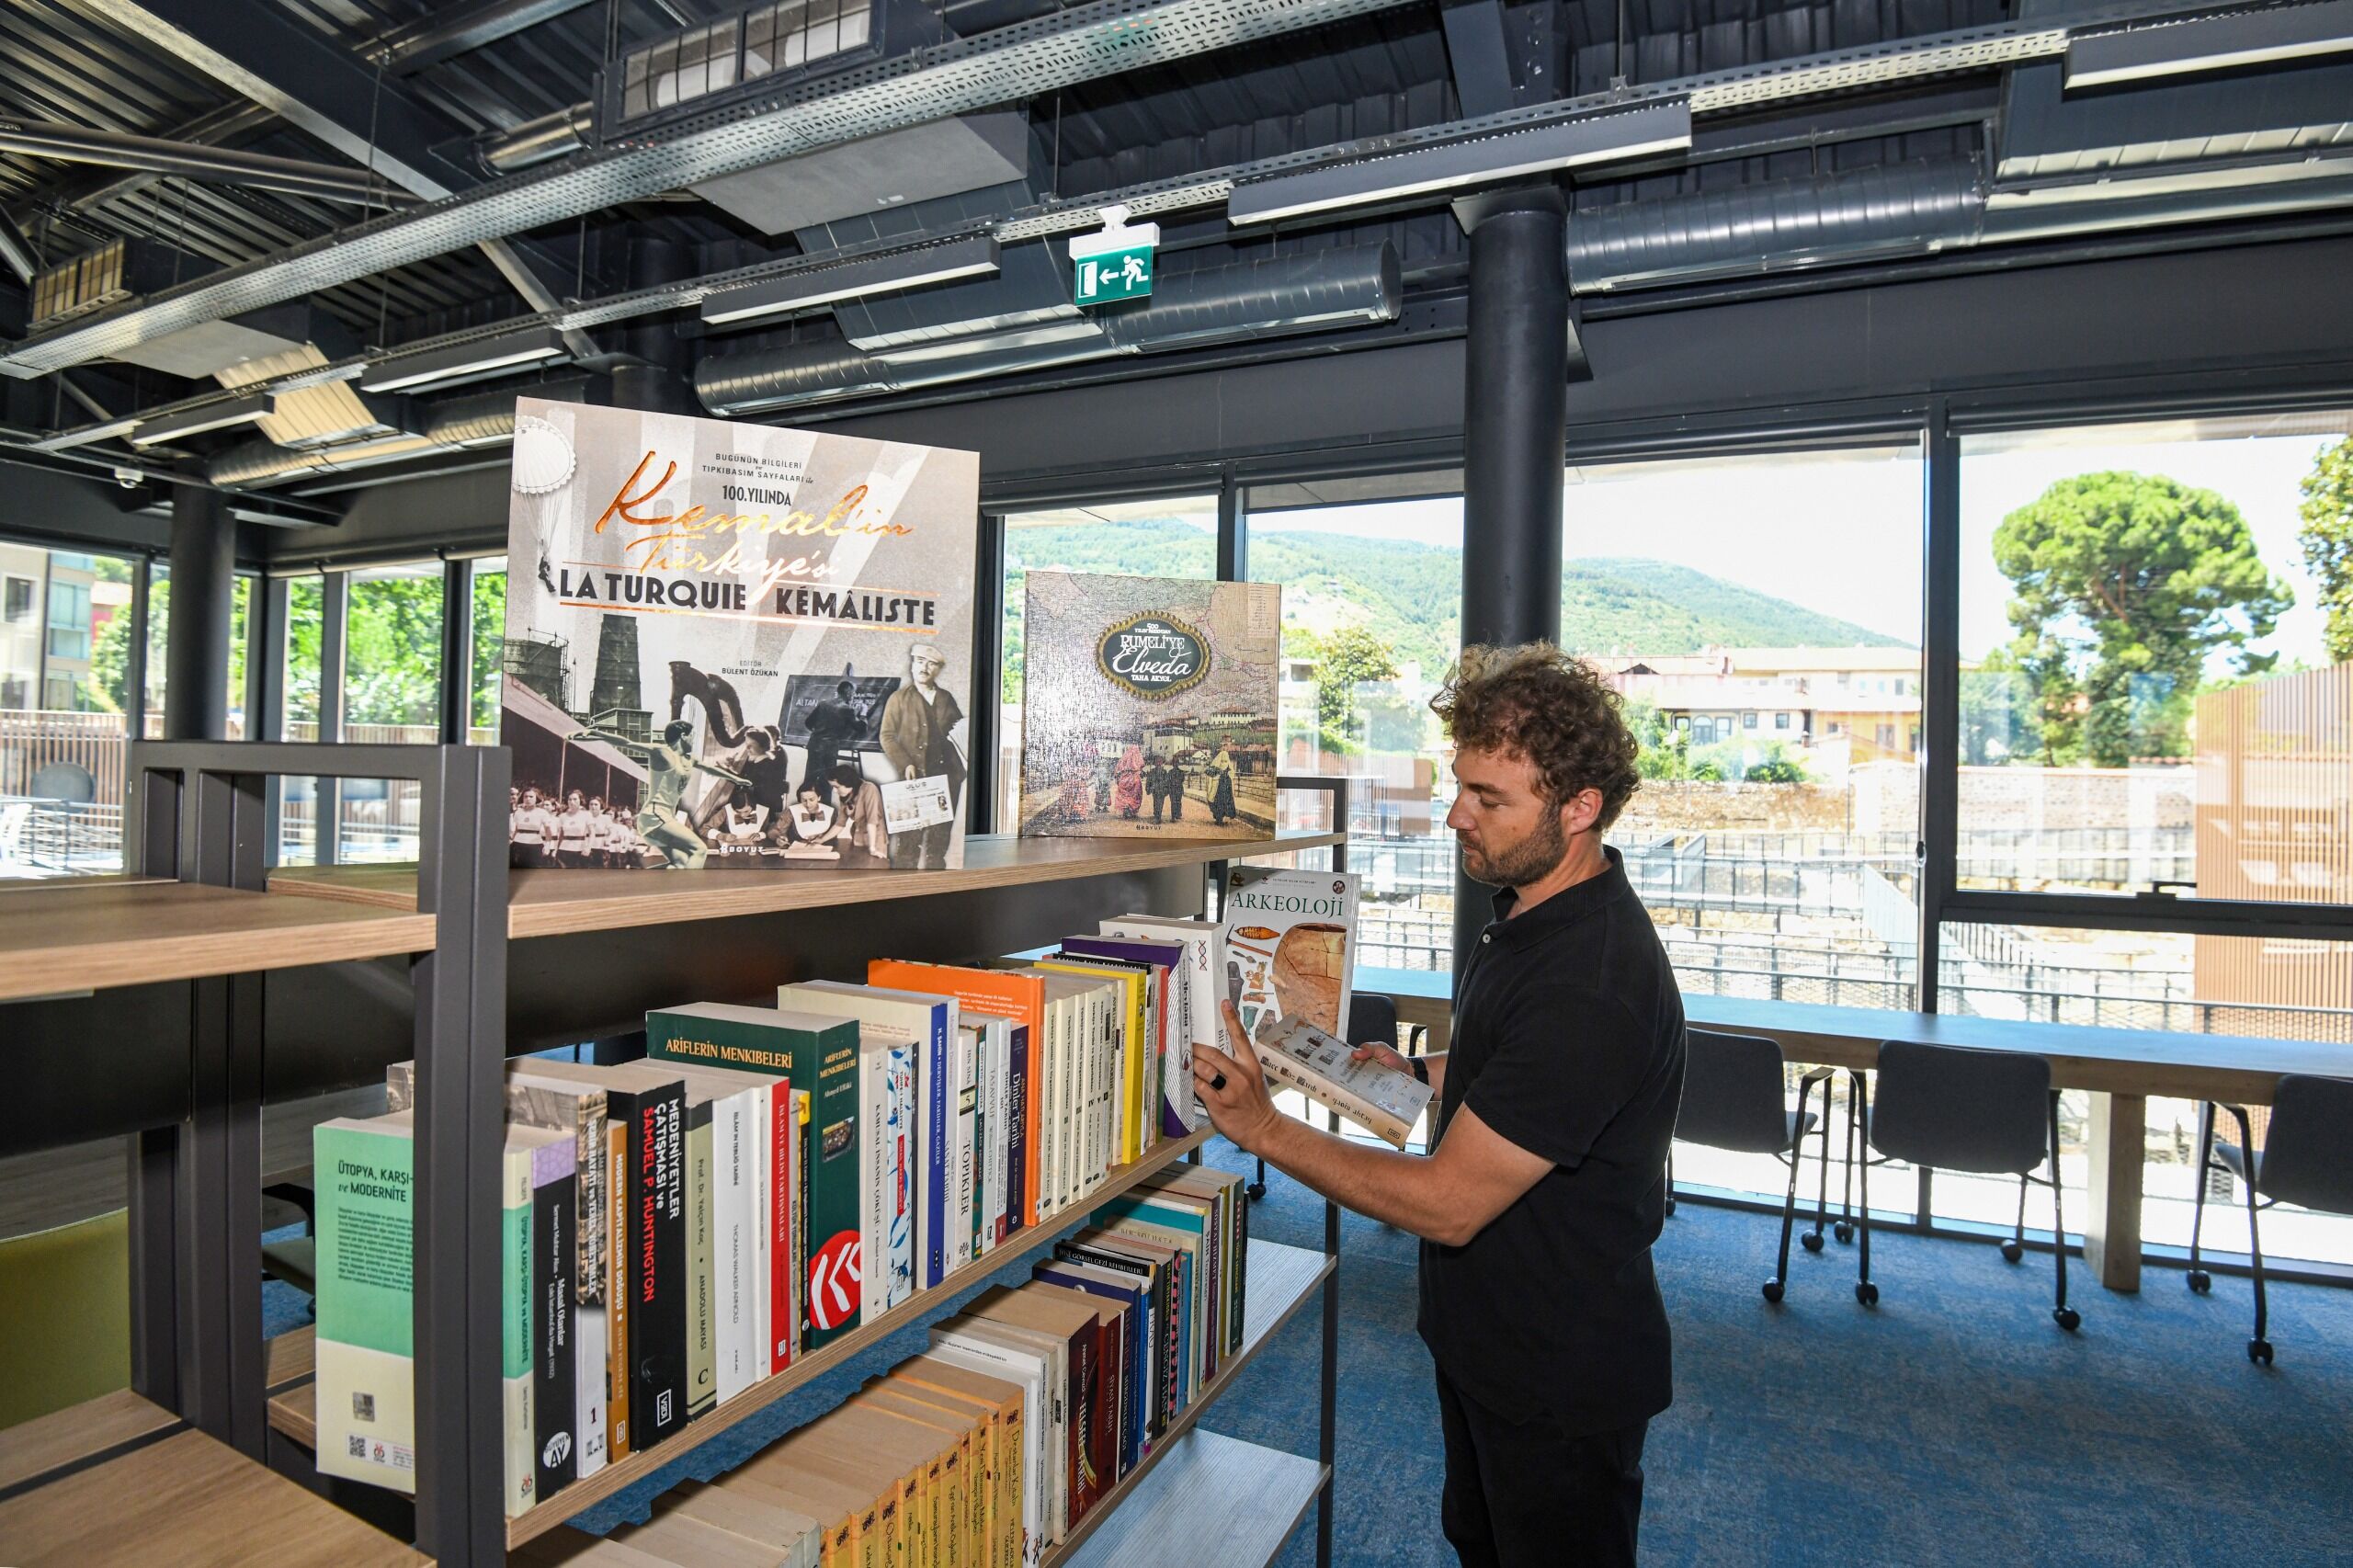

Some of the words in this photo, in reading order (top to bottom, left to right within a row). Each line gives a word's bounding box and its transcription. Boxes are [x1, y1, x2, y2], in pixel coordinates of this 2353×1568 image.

[702, 465, 754, 477] TIPKIBASIM
[757, 472, 803, 483] SAYFALARI
[715, 453, 758, 464] BUGÜNÜN
[762, 459, 802, 469] BİLGİLERİ
[595, 451, 914, 539] Kemal'in
[722, 484, 791, 506] 100.YILINDA
[561, 569, 597, 599] LA
[605, 573, 746, 610] TURQUIE
[777, 585, 935, 626] KÉMÂLISTE
[1120, 634, 1185, 649] RUMELİ'YE
[722, 667, 748, 676] BÜLENT
[750, 668, 779, 677] ÖZÜKAN
[1112, 646, 1192, 676] Elveda
[665, 1037, 718, 1058] ARİFLERİN
[721, 1046, 792, 1069] MENKIBELERİ
[824, 1047, 852, 1064] ARİFLERİN
[1218, 1030, 1228, 1052] BİLİ
[819, 1059, 857, 1079] MENKIBELERİ
[1012, 1073, 1021, 1110] Dinler
[643, 1108, 654, 1174] SAMUEL
[1011, 1112, 1020, 1149] Tarihi
[655, 1103, 667, 1189] ÇATIŞMASI
[669, 1098, 682, 1221] MEDENİYETLER
[338, 1160, 378, 1180] ÜTOPYA,
[616, 1153, 624, 1197] MODERN
[961, 1141, 972, 1216] TOPİKLER
[338, 1183, 349, 1193] ve
[350, 1182, 406, 1202] MODERNİTE
[643, 1178, 654, 1193] P.
[655, 1192, 665, 1210] ve
[616, 1199, 624, 1268] KAPİTALİZMİN
[643, 1198, 654, 1302] HUNTINGTON
[1072, 1253, 1093, 1264] GÖRSEL
[1094, 1258, 1108, 1267] GEZİ
[614, 1270, 623, 1311] DOĞUŞU
[1162, 1333, 1170, 1382] CENGİZ
[1161, 1385, 1169, 1414] HAN
